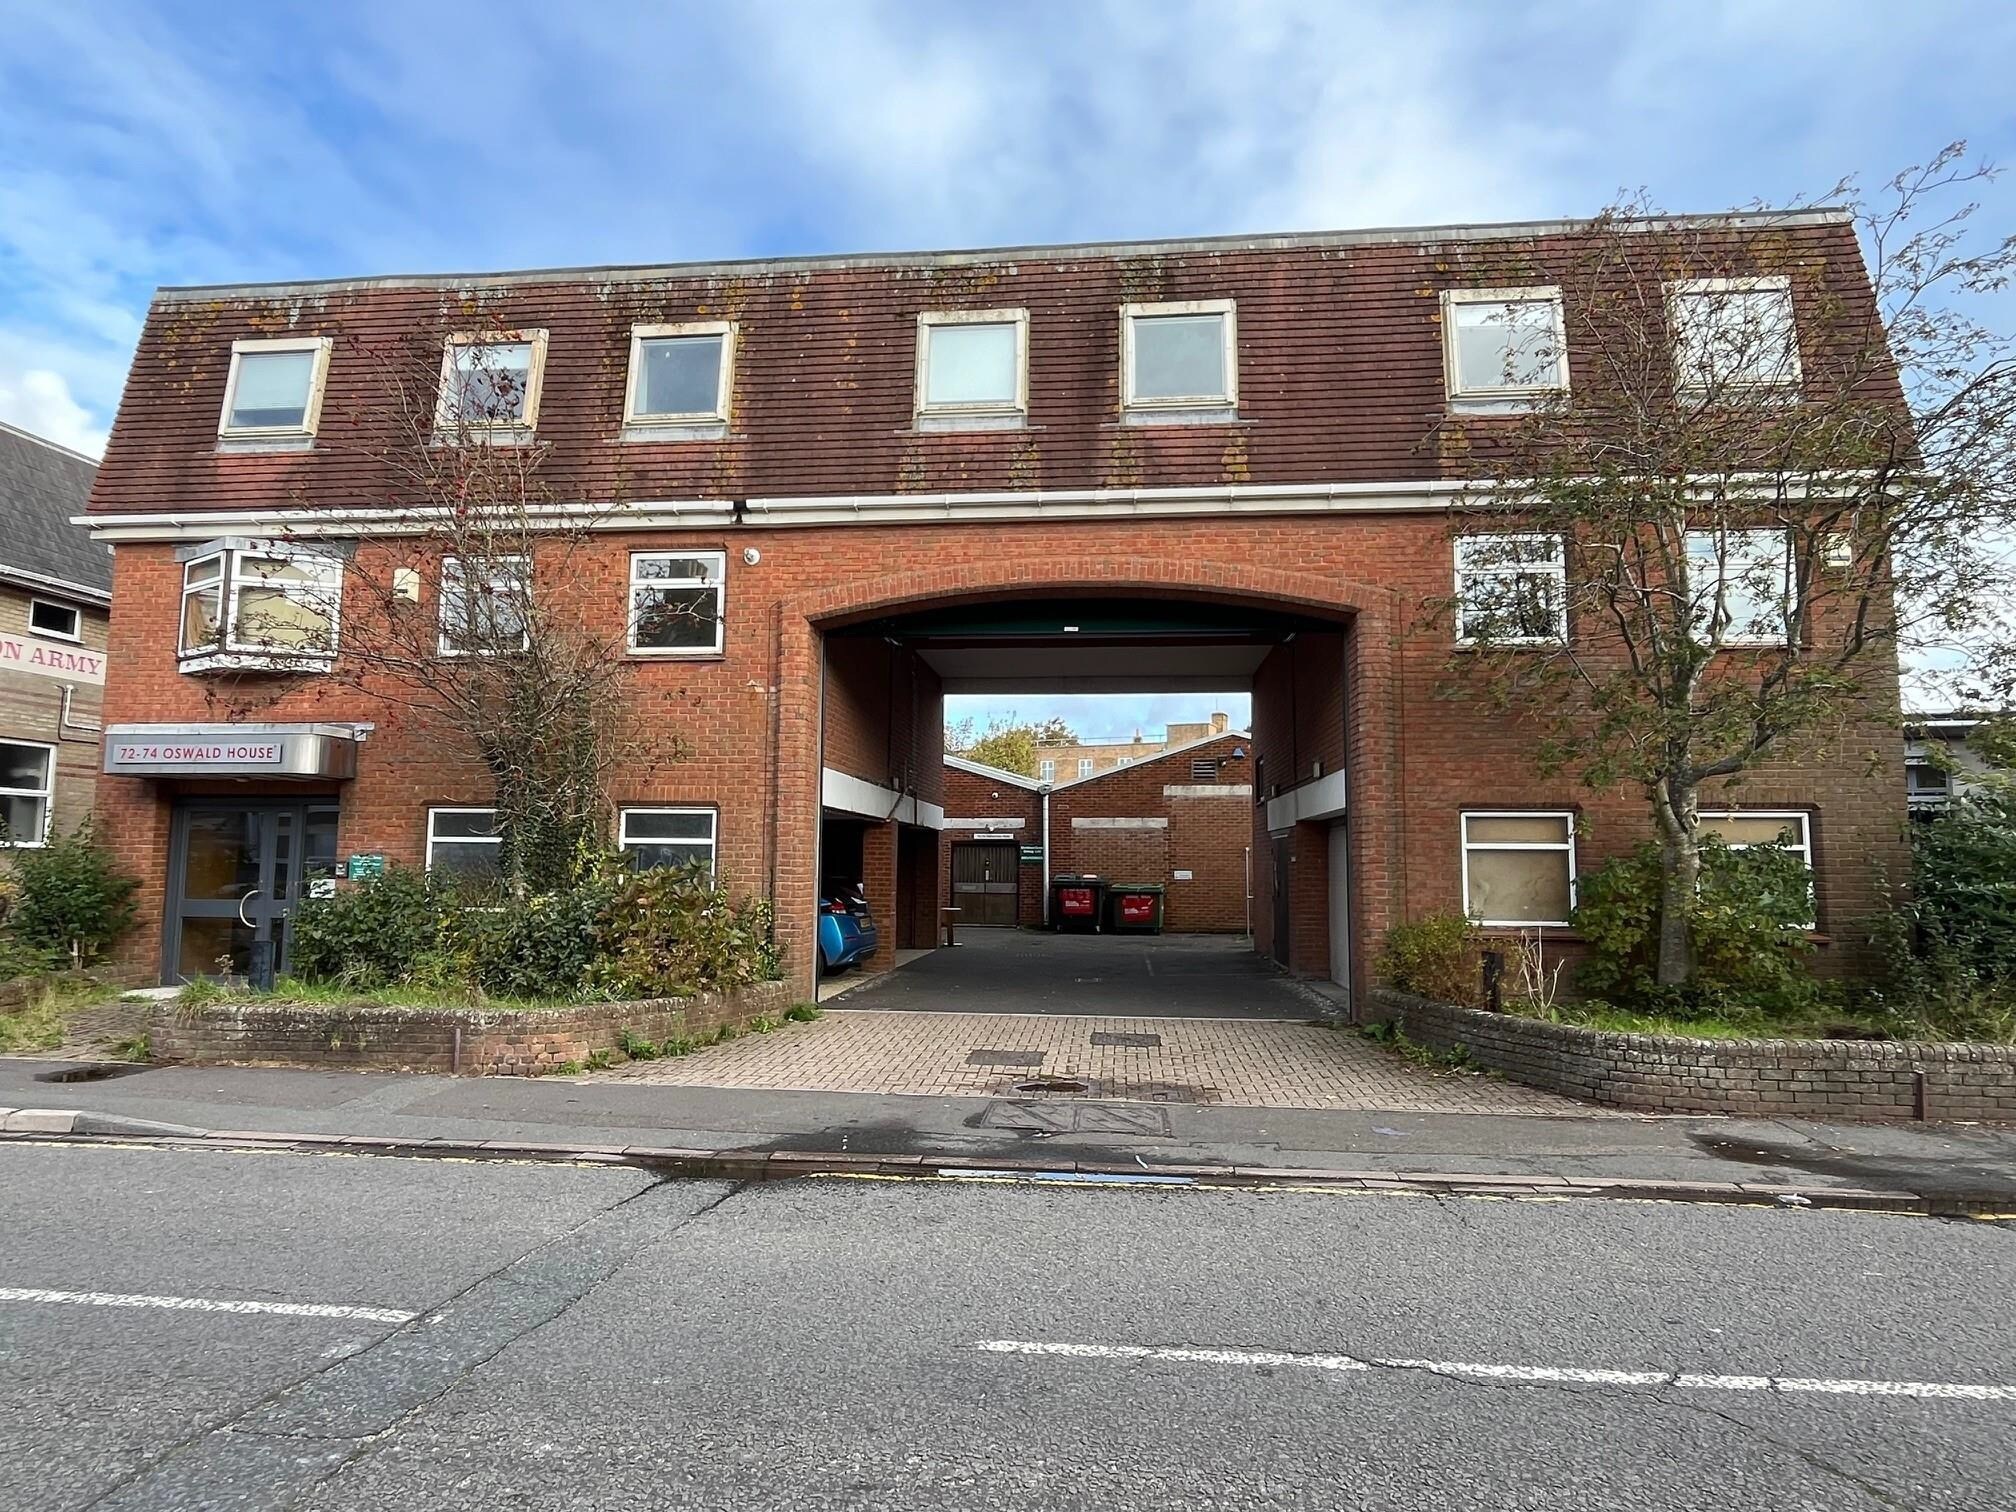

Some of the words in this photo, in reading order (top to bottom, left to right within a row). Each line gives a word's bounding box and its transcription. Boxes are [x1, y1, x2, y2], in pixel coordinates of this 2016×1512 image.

[0, 640, 24, 660] N
[29, 647, 103, 675] ARMY
[120, 748, 158, 760] 72-74
[163, 747, 222, 760] OSWALD
[227, 747, 274, 759] HOUSE
